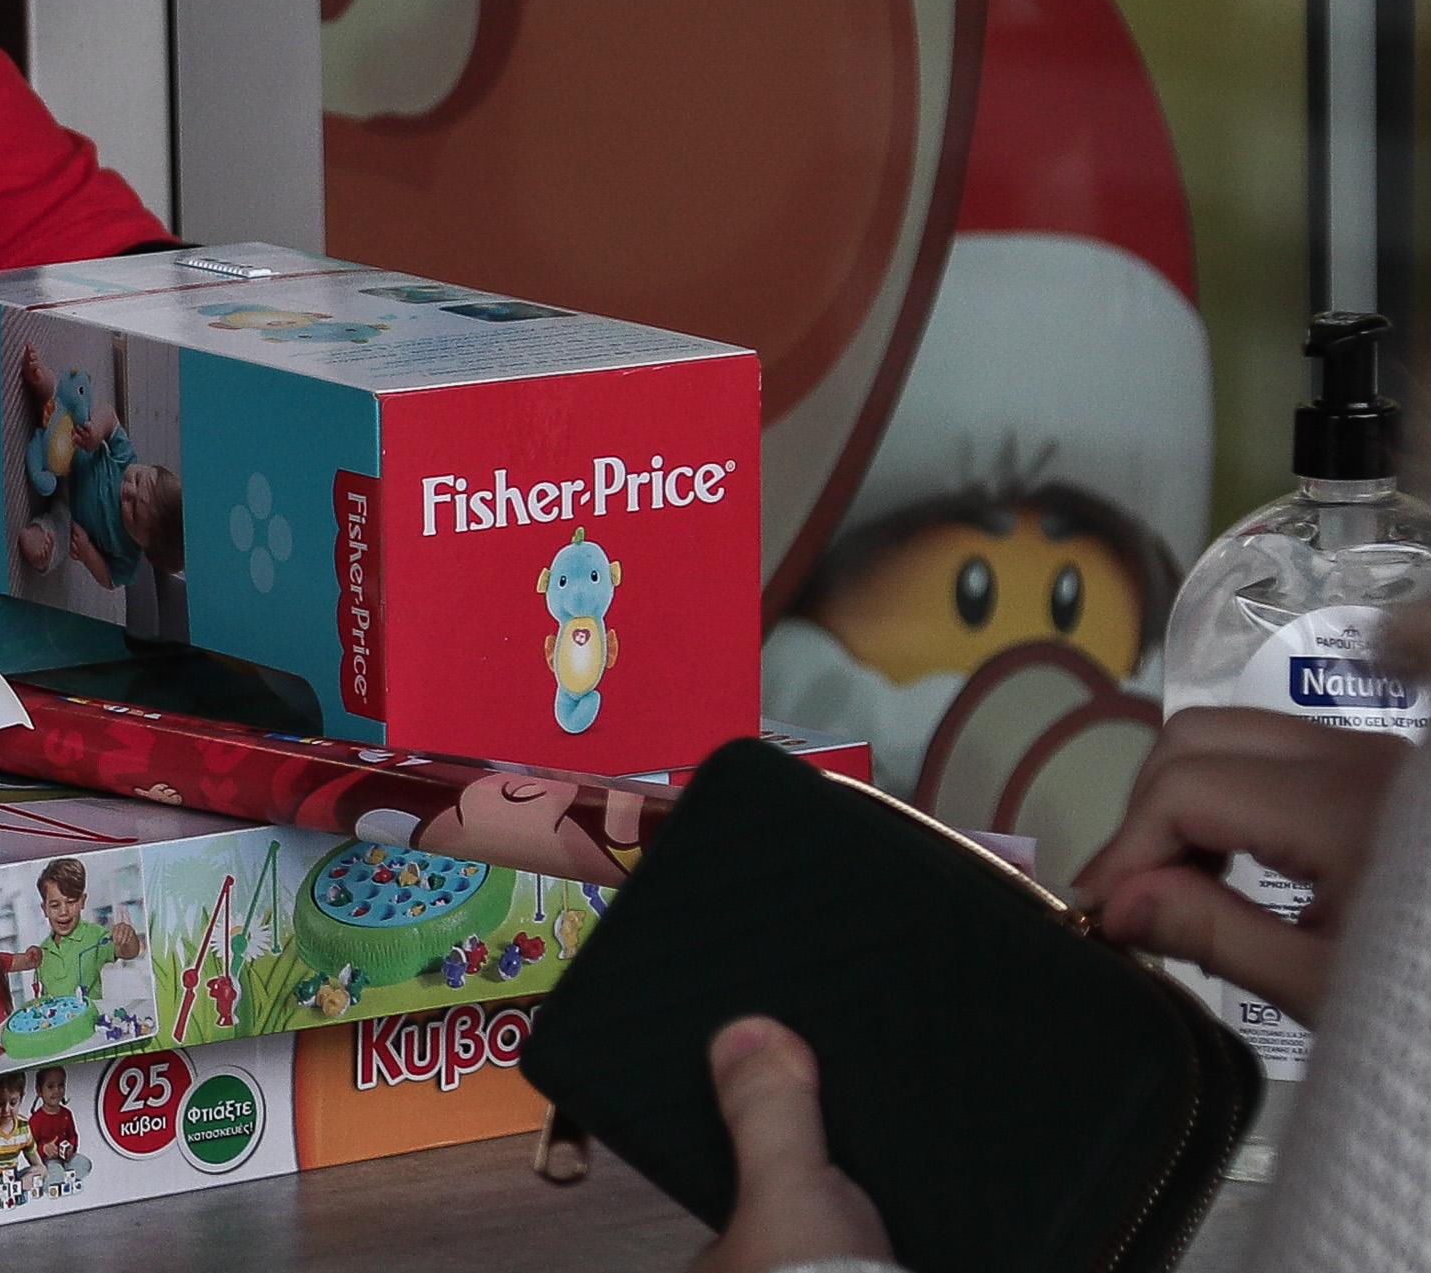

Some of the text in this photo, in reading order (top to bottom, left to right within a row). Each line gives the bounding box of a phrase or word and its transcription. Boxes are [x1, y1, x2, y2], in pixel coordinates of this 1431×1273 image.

[421, 454, 727, 536] Fisher-Price
[345, 491, 370, 698] Fisher-Price
[1365, 716, 1388, 726] GEL
[118, 1063, 172, 1112] 25
[121, 1114, 167, 1138] κύβοι
[187, 1099, 253, 1126] Φτιάξτε
[187, 1122, 254, 1144] κατασκευές!
